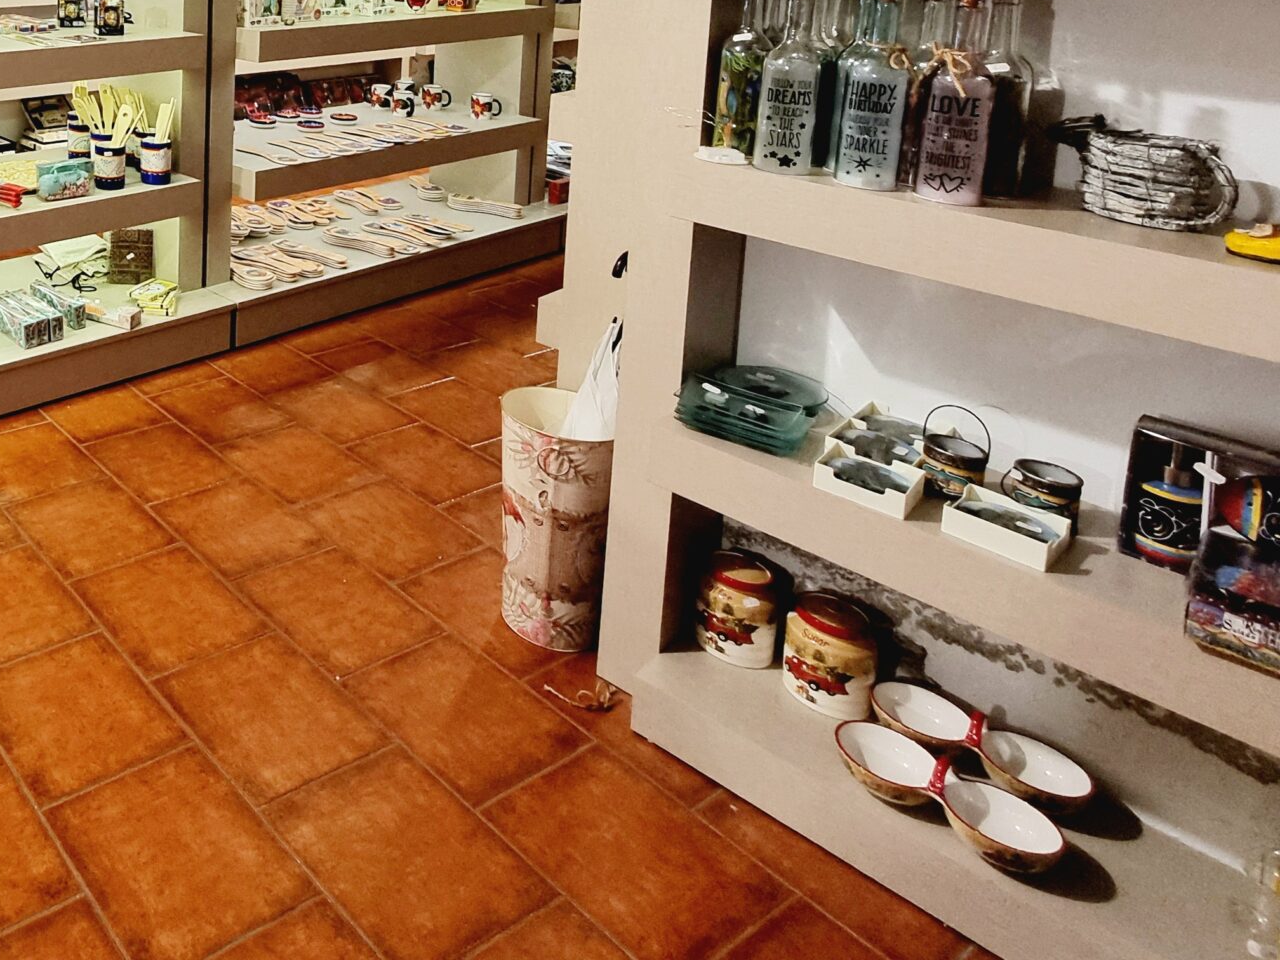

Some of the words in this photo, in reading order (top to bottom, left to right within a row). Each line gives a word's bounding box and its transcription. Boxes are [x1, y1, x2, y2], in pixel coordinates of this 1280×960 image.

[767, 88, 812, 106] DREAMS
[851, 80, 897, 102] HAPPY
[848, 97, 896, 114] BIRTHDAY
[931, 94, 981, 118] LOVE
[768, 129, 801, 149] STARS
[844, 133, 888, 155] SPARKLE
